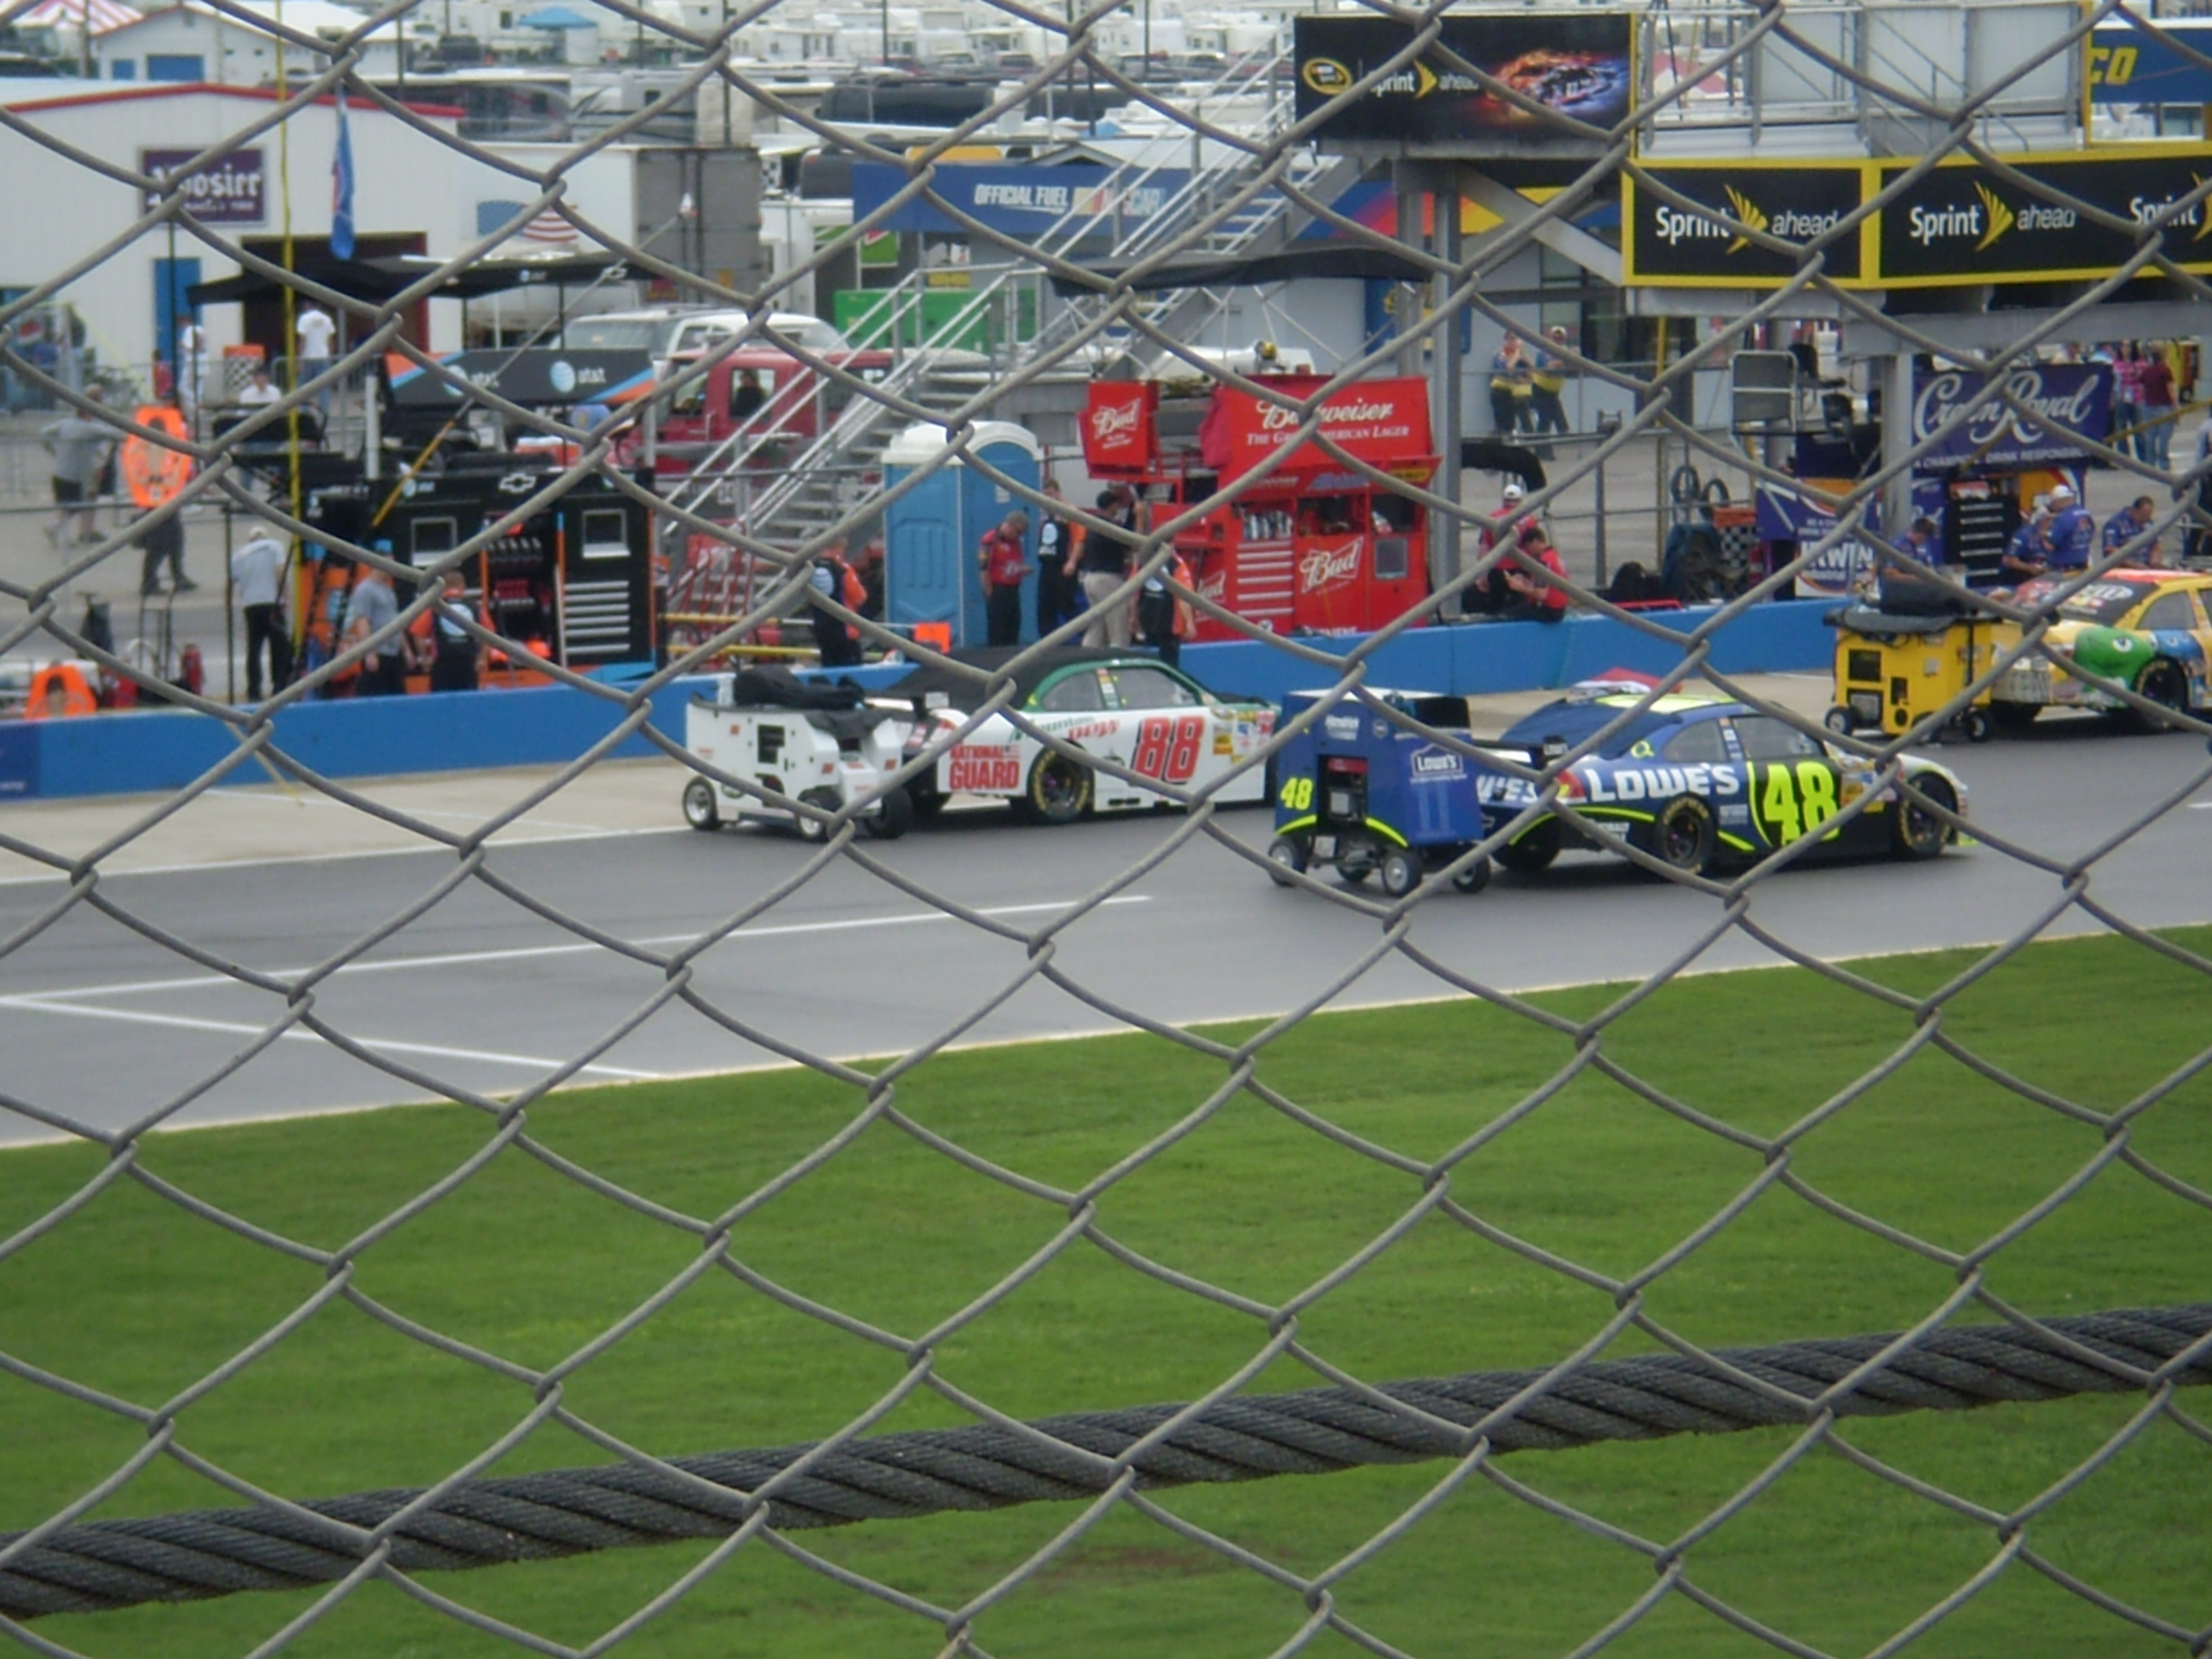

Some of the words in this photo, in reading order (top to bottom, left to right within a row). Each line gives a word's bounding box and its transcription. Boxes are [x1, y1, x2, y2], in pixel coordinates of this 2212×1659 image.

[1370, 70, 1416, 98] print
[1439, 74, 1479, 91] ahea
[974, 184, 1033, 206] OFFICIAL
[1035, 186, 1069, 207] FUEL
[1655, 206, 1730, 246] Sprint
[1771, 210, 1838, 236] ahead
[1910, 204, 1980, 246] Sprint
[2017, 203, 2077, 230] ahead
[1092, 399, 1141, 436] Bud
[1256, 397, 1394, 430] Buweiser
[1913, 373, 2001, 441] Crn
[1315, 429, 1369, 441] MERICAN
[1299, 540, 1361, 589] Bud
[949, 745, 1004, 759] NATIONAL
[1129, 715, 1205, 785] 88
[949, 760, 1020, 790] GUARD
[1585, 762, 1740, 803] LOWE'S
[1280, 777, 1313, 811] 48
[1764, 760, 1843, 847] 48
